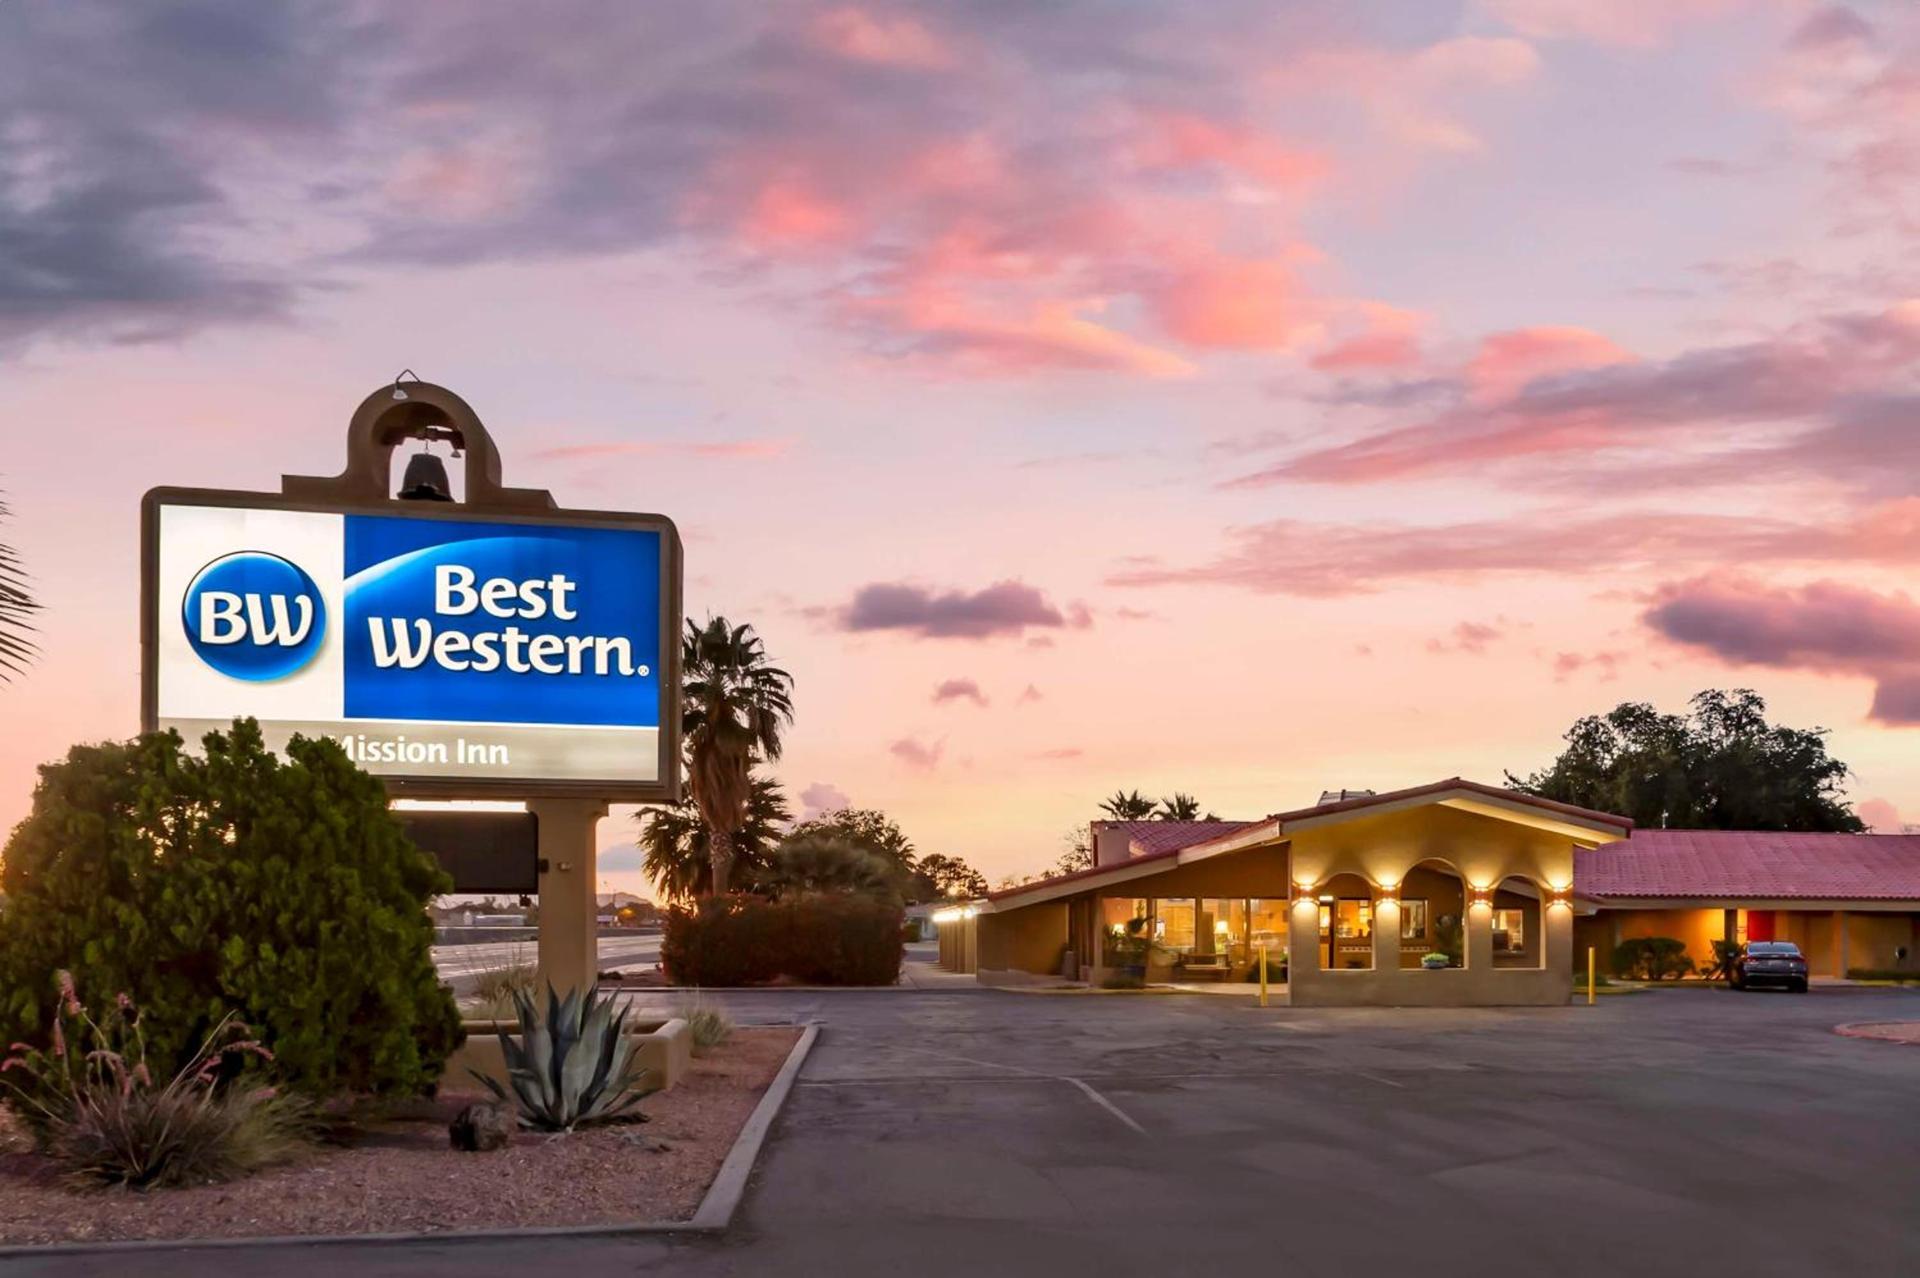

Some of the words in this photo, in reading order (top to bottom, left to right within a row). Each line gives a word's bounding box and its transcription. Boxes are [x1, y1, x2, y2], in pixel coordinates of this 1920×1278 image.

[199, 592, 313, 646] BW
[436, 565, 577, 619] Best
[457, 738, 510, 765] Inn
